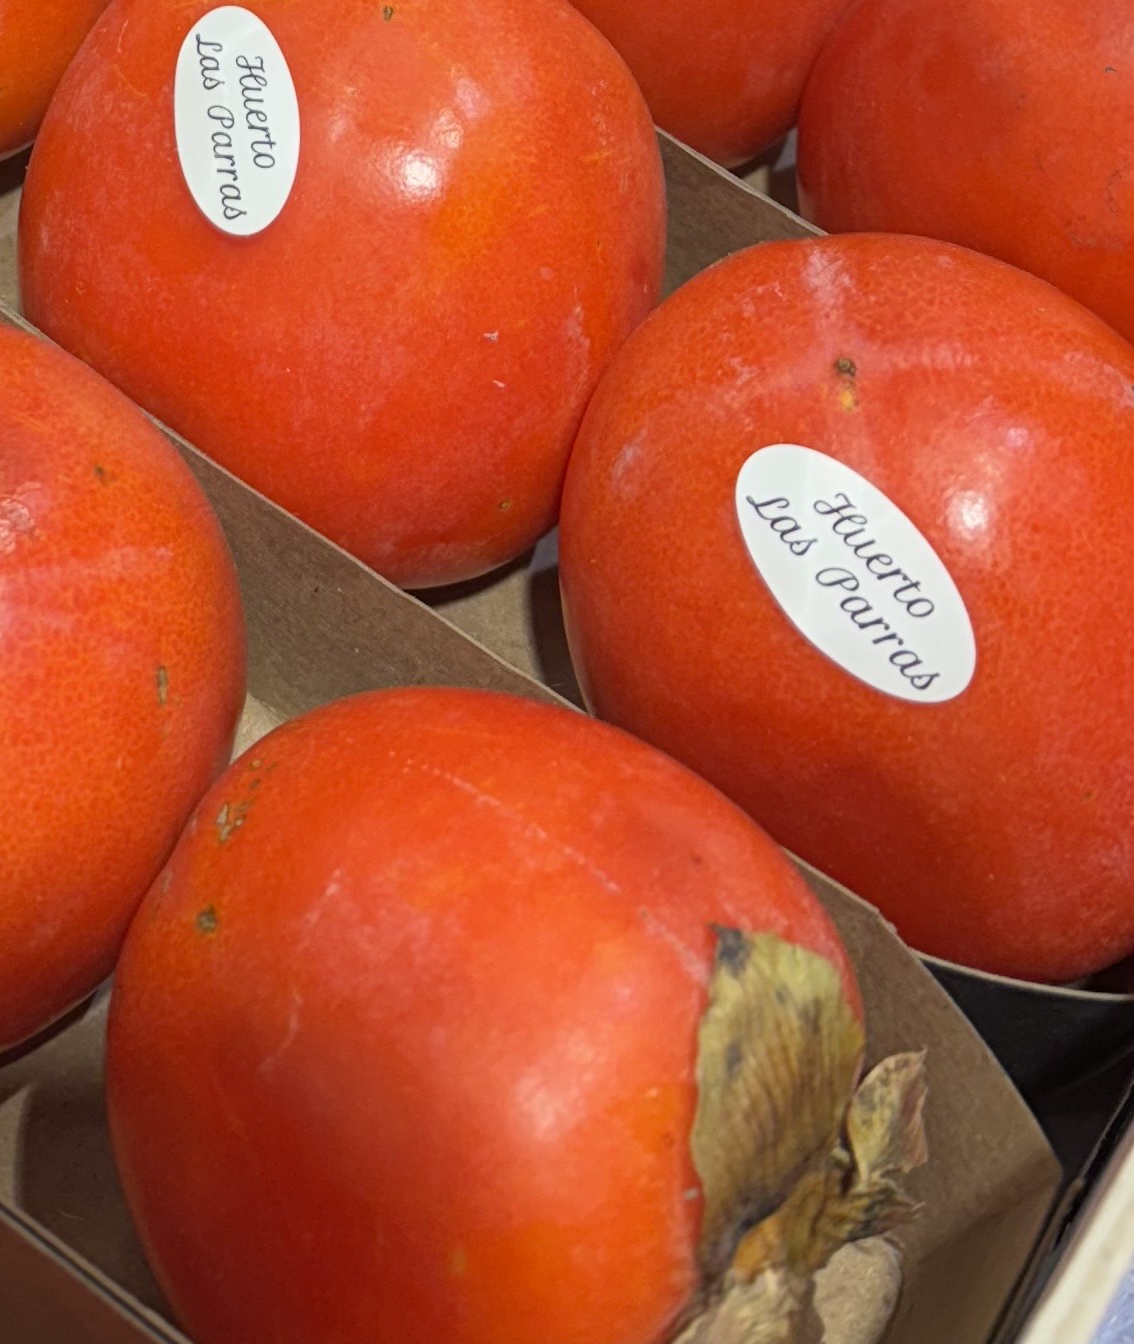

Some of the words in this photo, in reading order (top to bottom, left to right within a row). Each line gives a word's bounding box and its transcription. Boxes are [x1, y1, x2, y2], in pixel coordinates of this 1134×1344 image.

[195, 33, 225, 91] Las
[235, 55, 276, 169] Huerto
[207, 105, 247, 221] Parras
[746, 495, 818, 556] Las
[815, 567, 940, 690] Parras
[813, 492, 935, 618] Huerto
